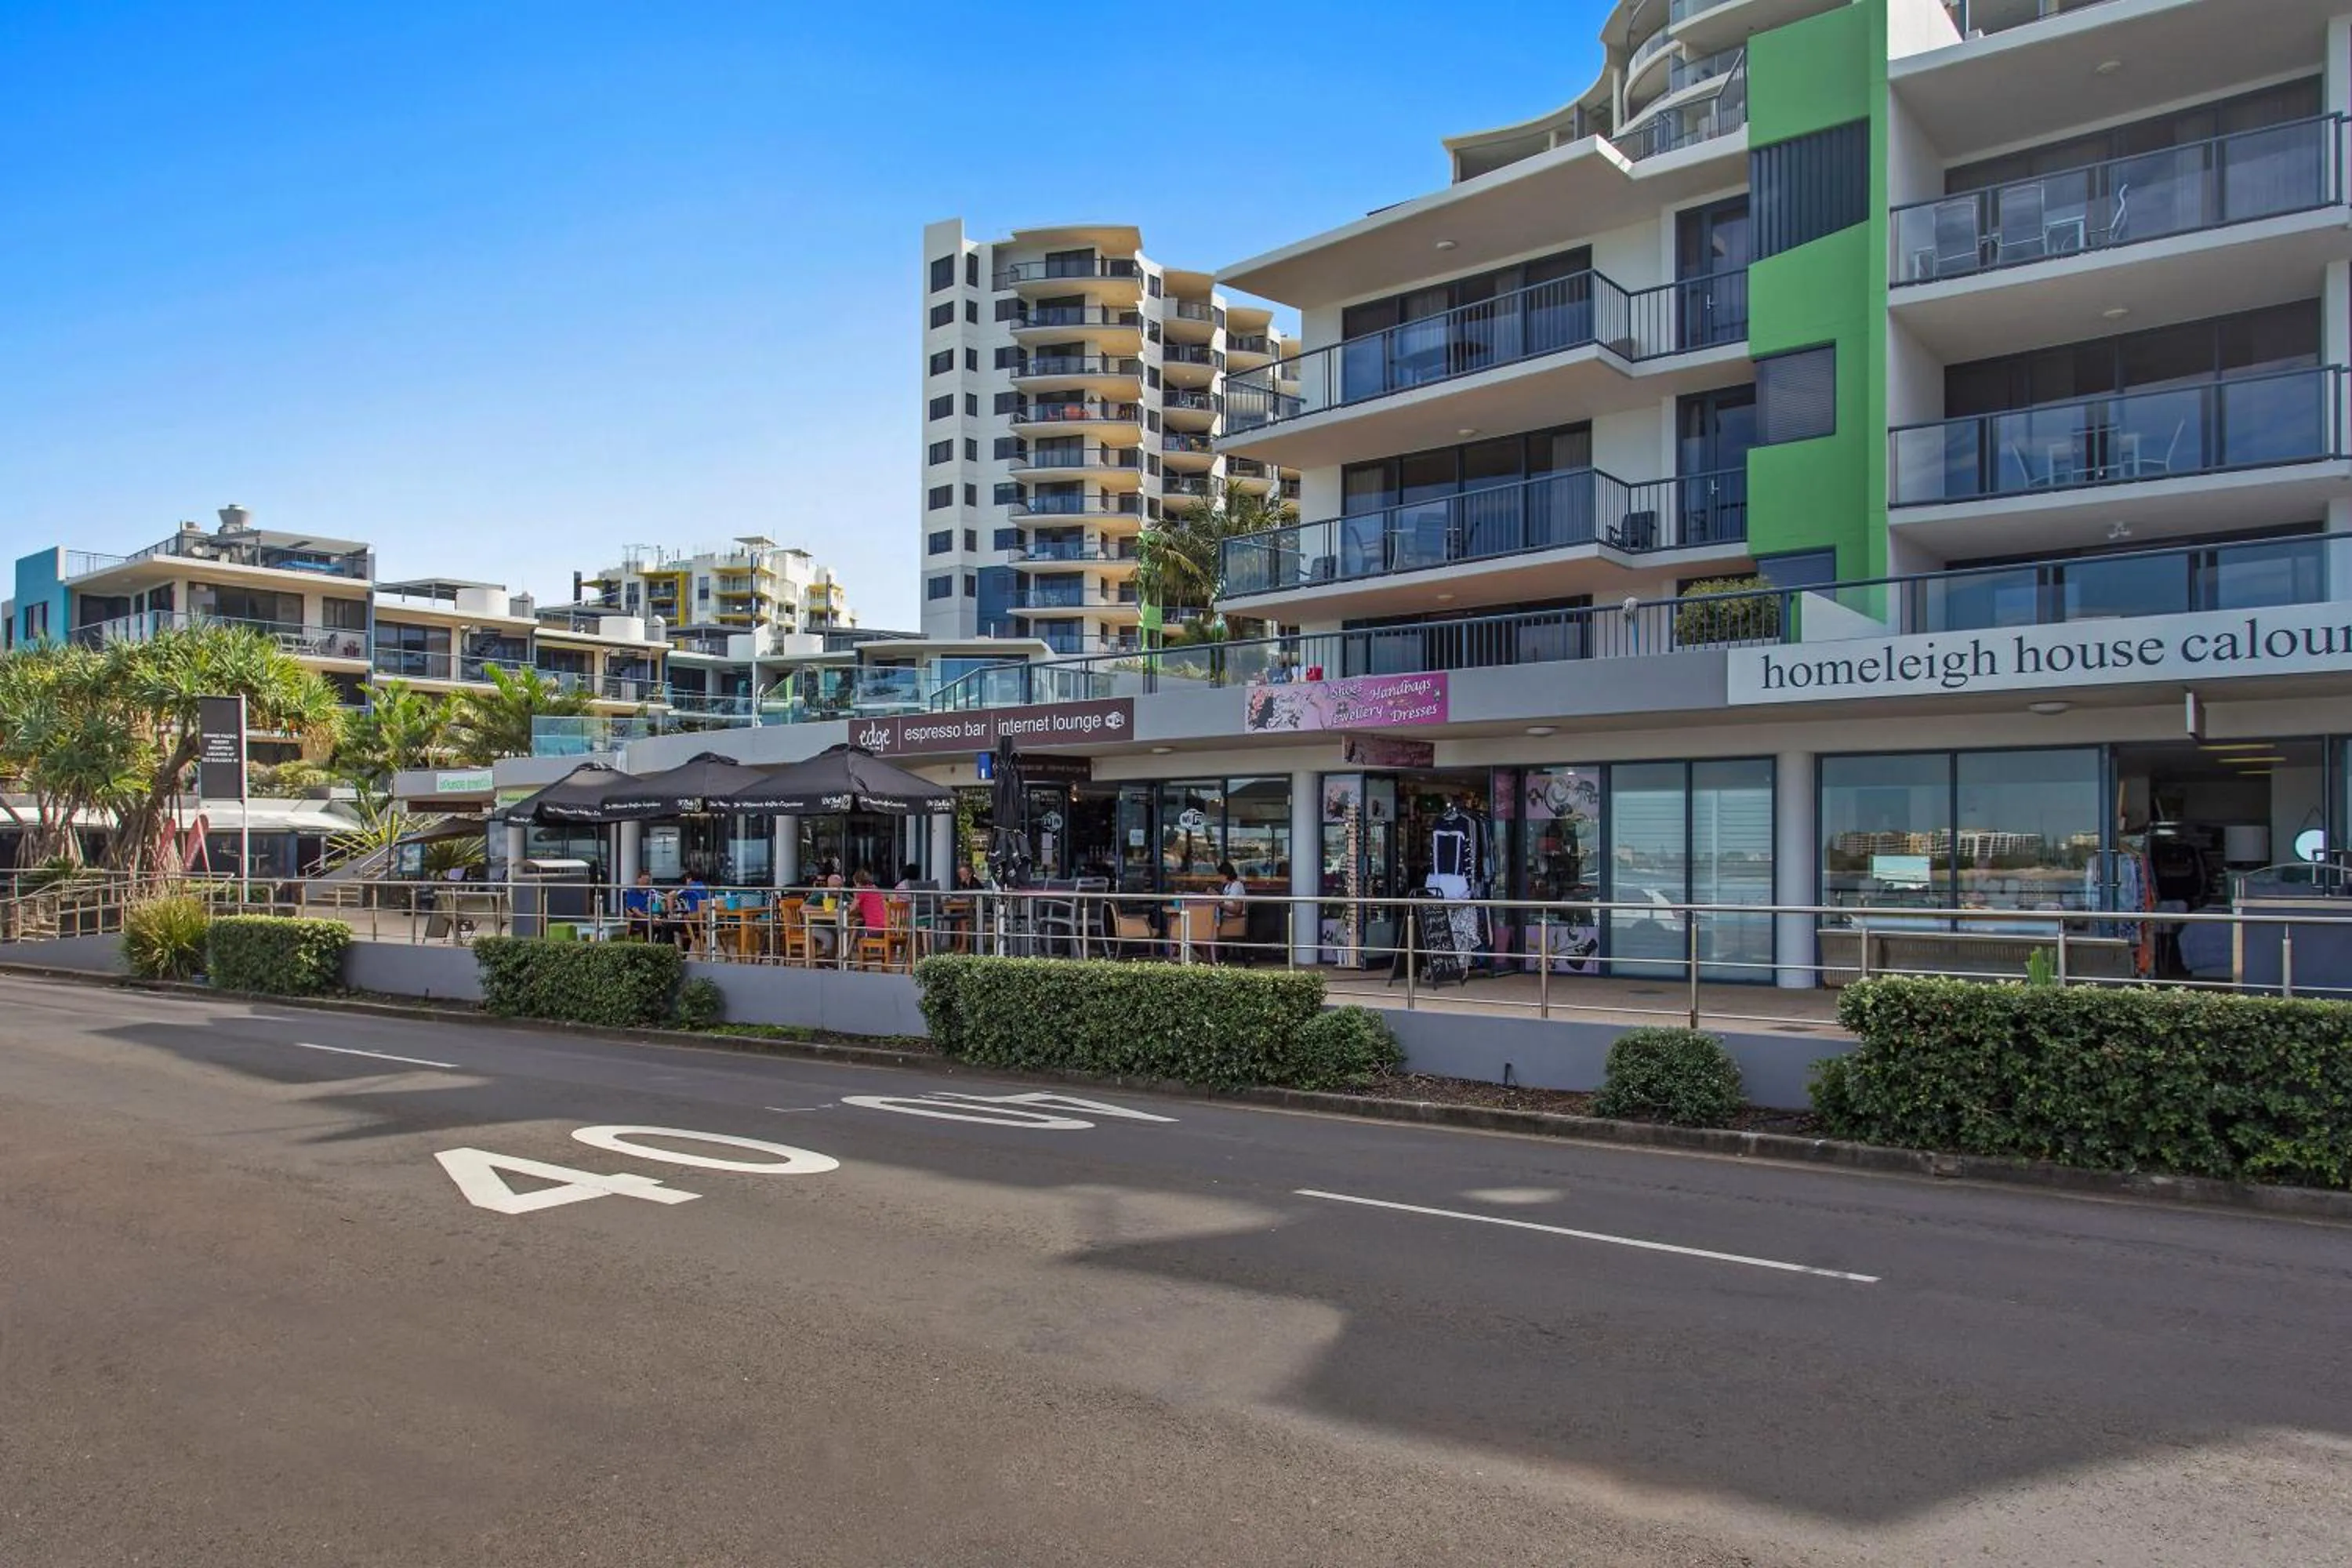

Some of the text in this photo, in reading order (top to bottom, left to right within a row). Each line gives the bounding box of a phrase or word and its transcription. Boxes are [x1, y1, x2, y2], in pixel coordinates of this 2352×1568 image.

[1762, 638, 1999, 688] homeleigh
[2013, 635, 2165, 673] house
[1370, 678, 1432, 701] Handbags
[858, 720, 891, 752] edge
[904, 724, 960, 744] espresso
[964, 720, 987, 737] bar
[997, 714, 1050, 735] internet
[1053, 713, 1102, 733] lounge
[1390, 704, 1438, 723] Dresses
[434, 1124, 840, 1215] 40
